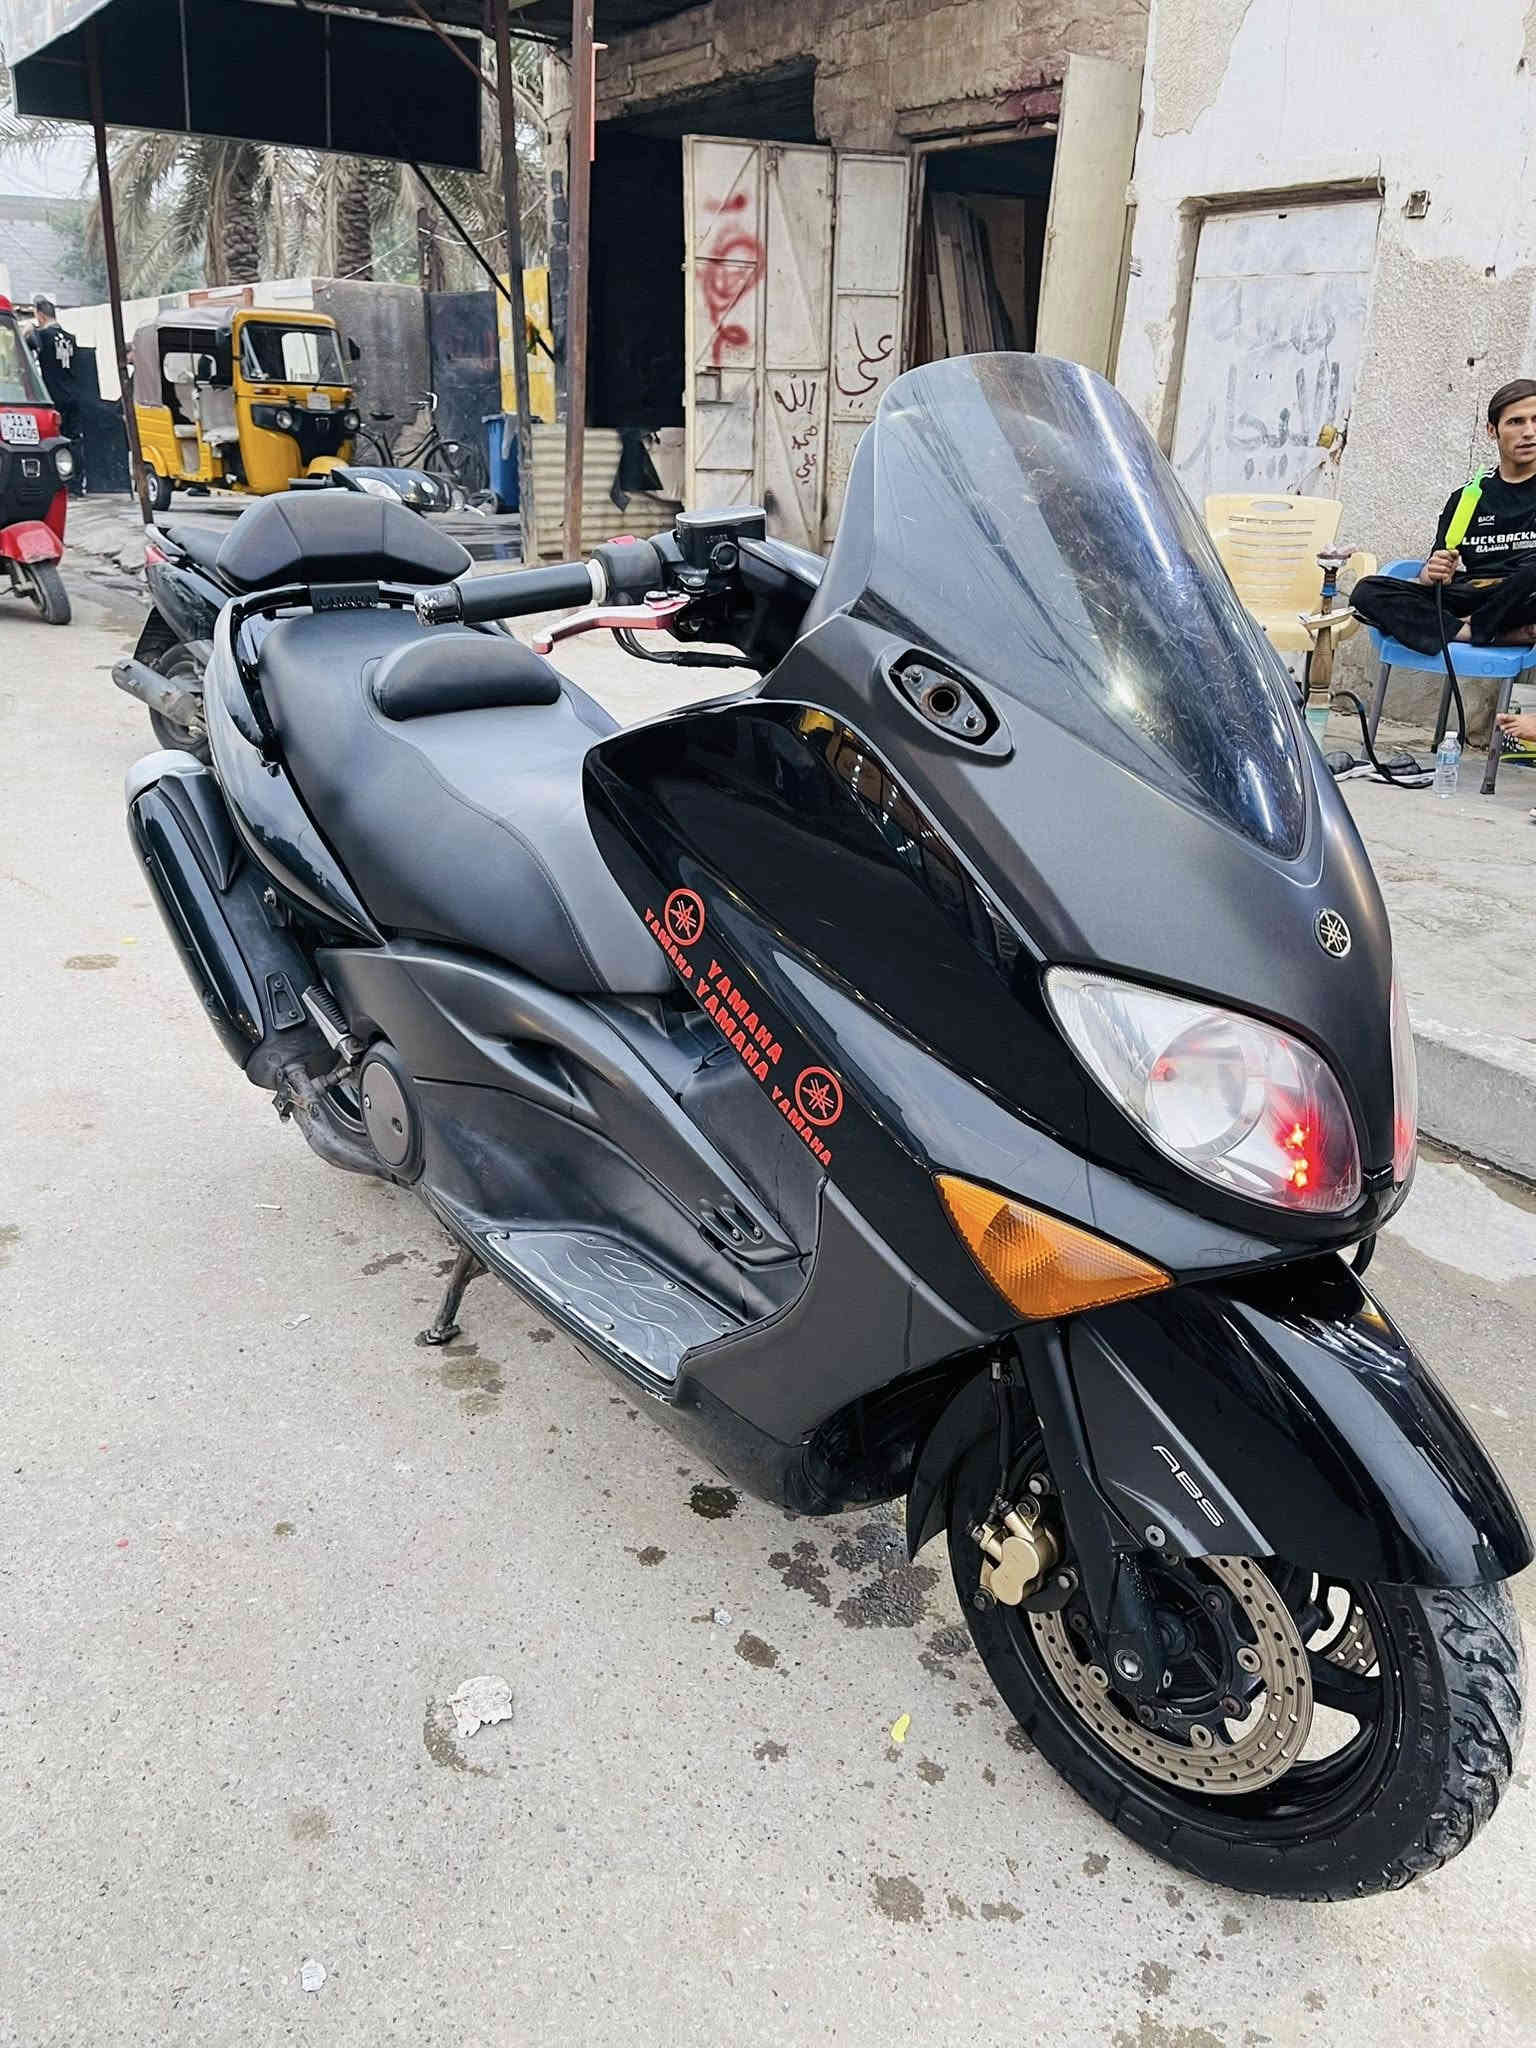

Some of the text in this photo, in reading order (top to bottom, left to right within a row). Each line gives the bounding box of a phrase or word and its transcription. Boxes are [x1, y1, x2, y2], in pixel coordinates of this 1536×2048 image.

[774, 380, 817, 415] الله
[834, 321, 895, 409] علي
[644, 907, 695, 979] YAMAHA
[696, 977, 770, 1083] YAMAHA
[707, 959, 784, 1065] YAMAHA
[771, 1085, 833, 1167] YAMAHA
[1152, 1445, 1225, 1527] ABS
